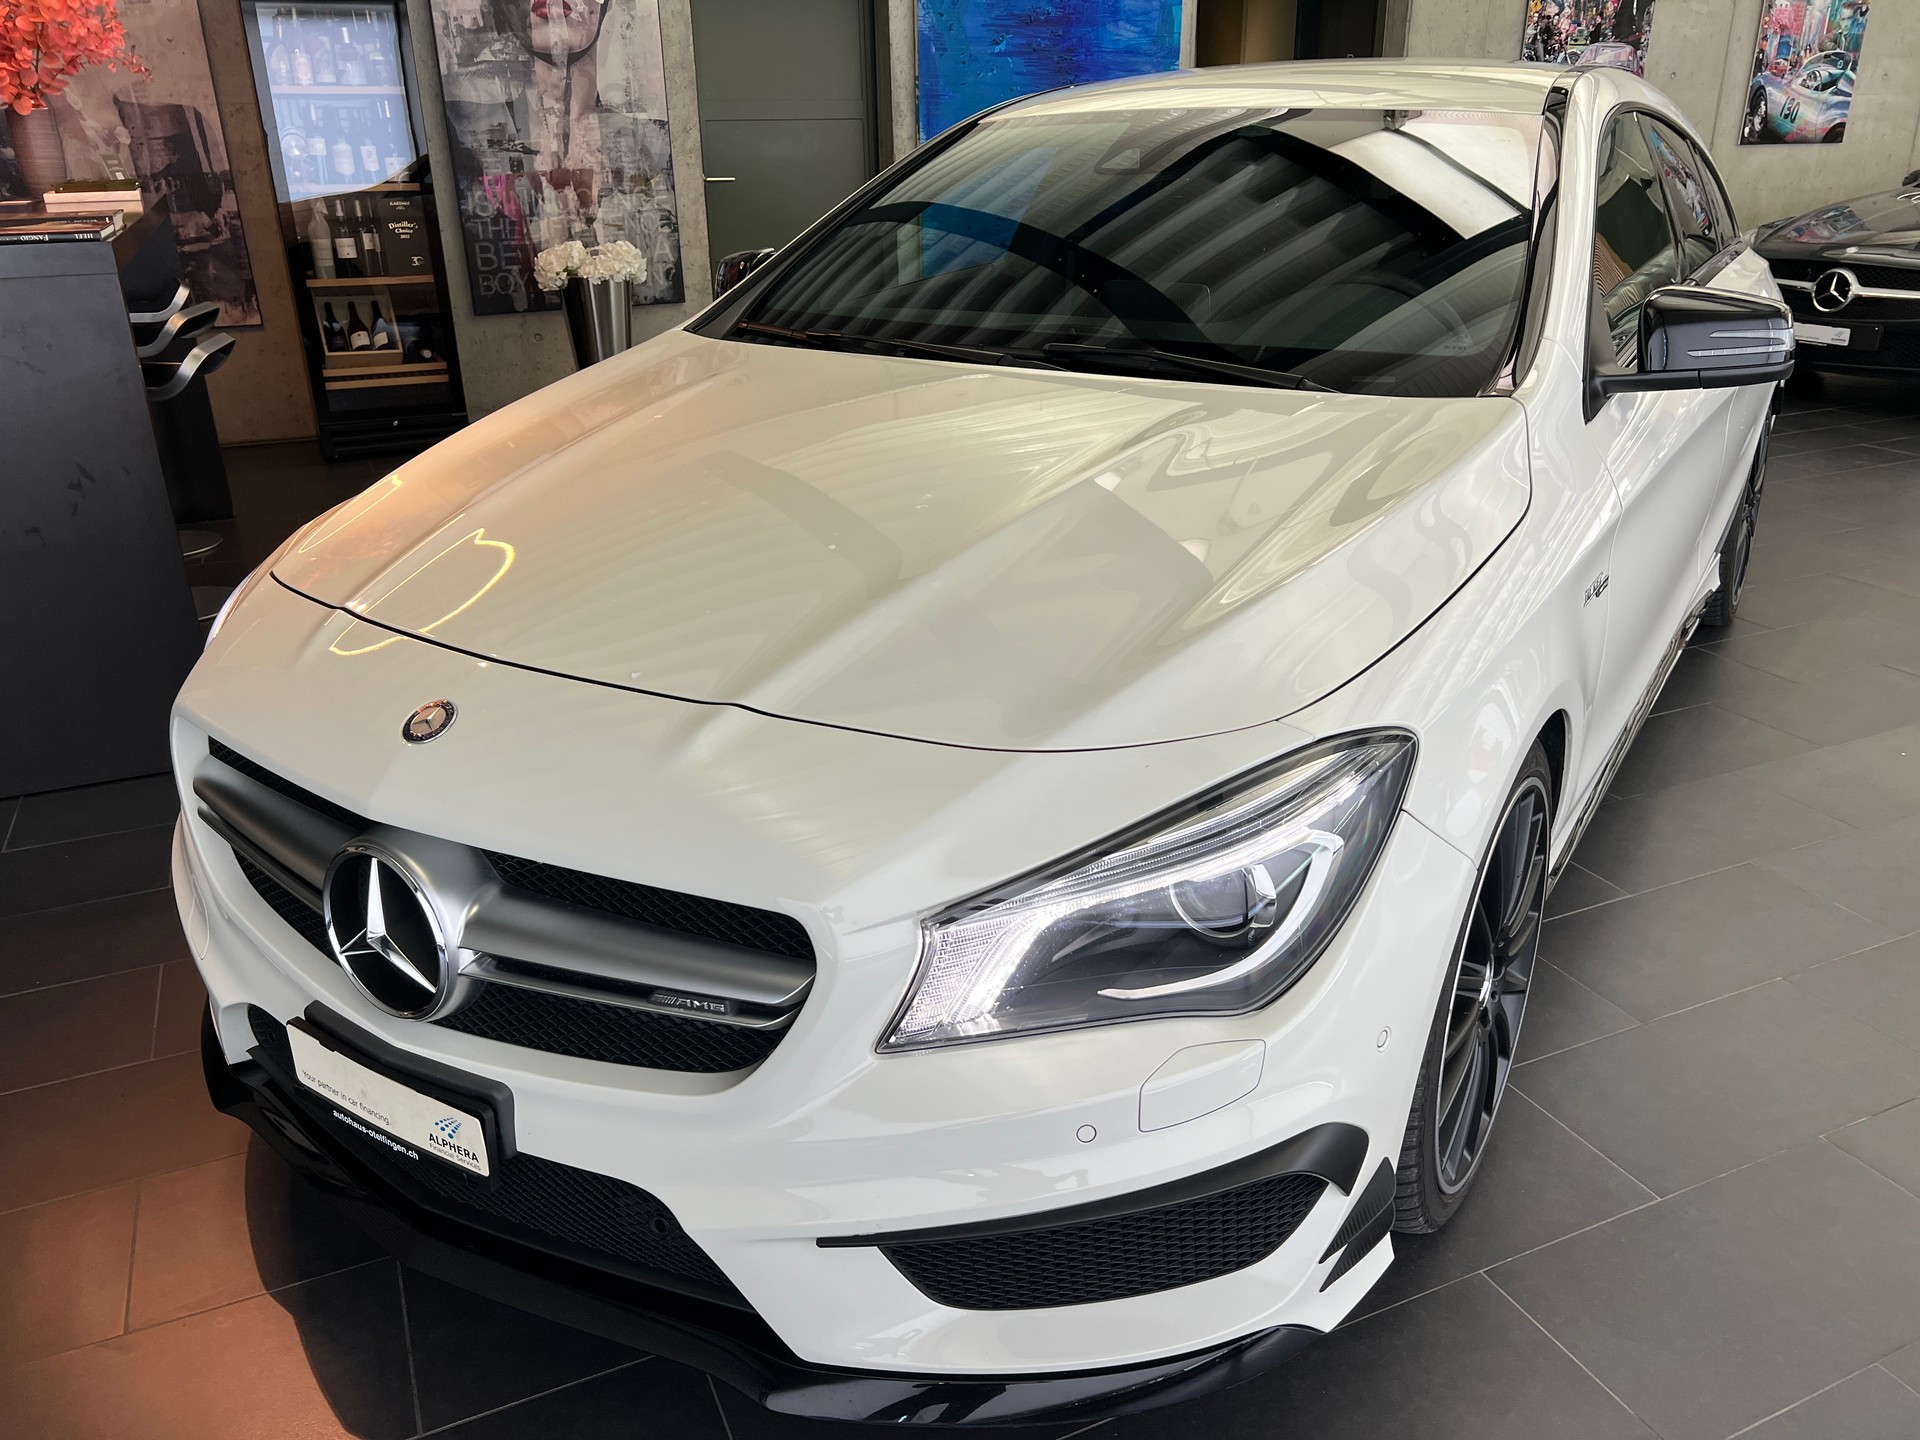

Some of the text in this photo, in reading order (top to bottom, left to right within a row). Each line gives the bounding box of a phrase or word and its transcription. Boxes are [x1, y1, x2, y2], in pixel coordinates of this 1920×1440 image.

[671, 996, 725, 1012] AMG
[317, 1079, 339, 1097] partner
[341, 1092, 347, 1102] in
[348, 1097, 359, 1107] car
[360, 1101, 392, 1125] financing.
[429, 1133, 480, 1163] ALPHERA
[429, 1143, 481, 1171] Financial Services
